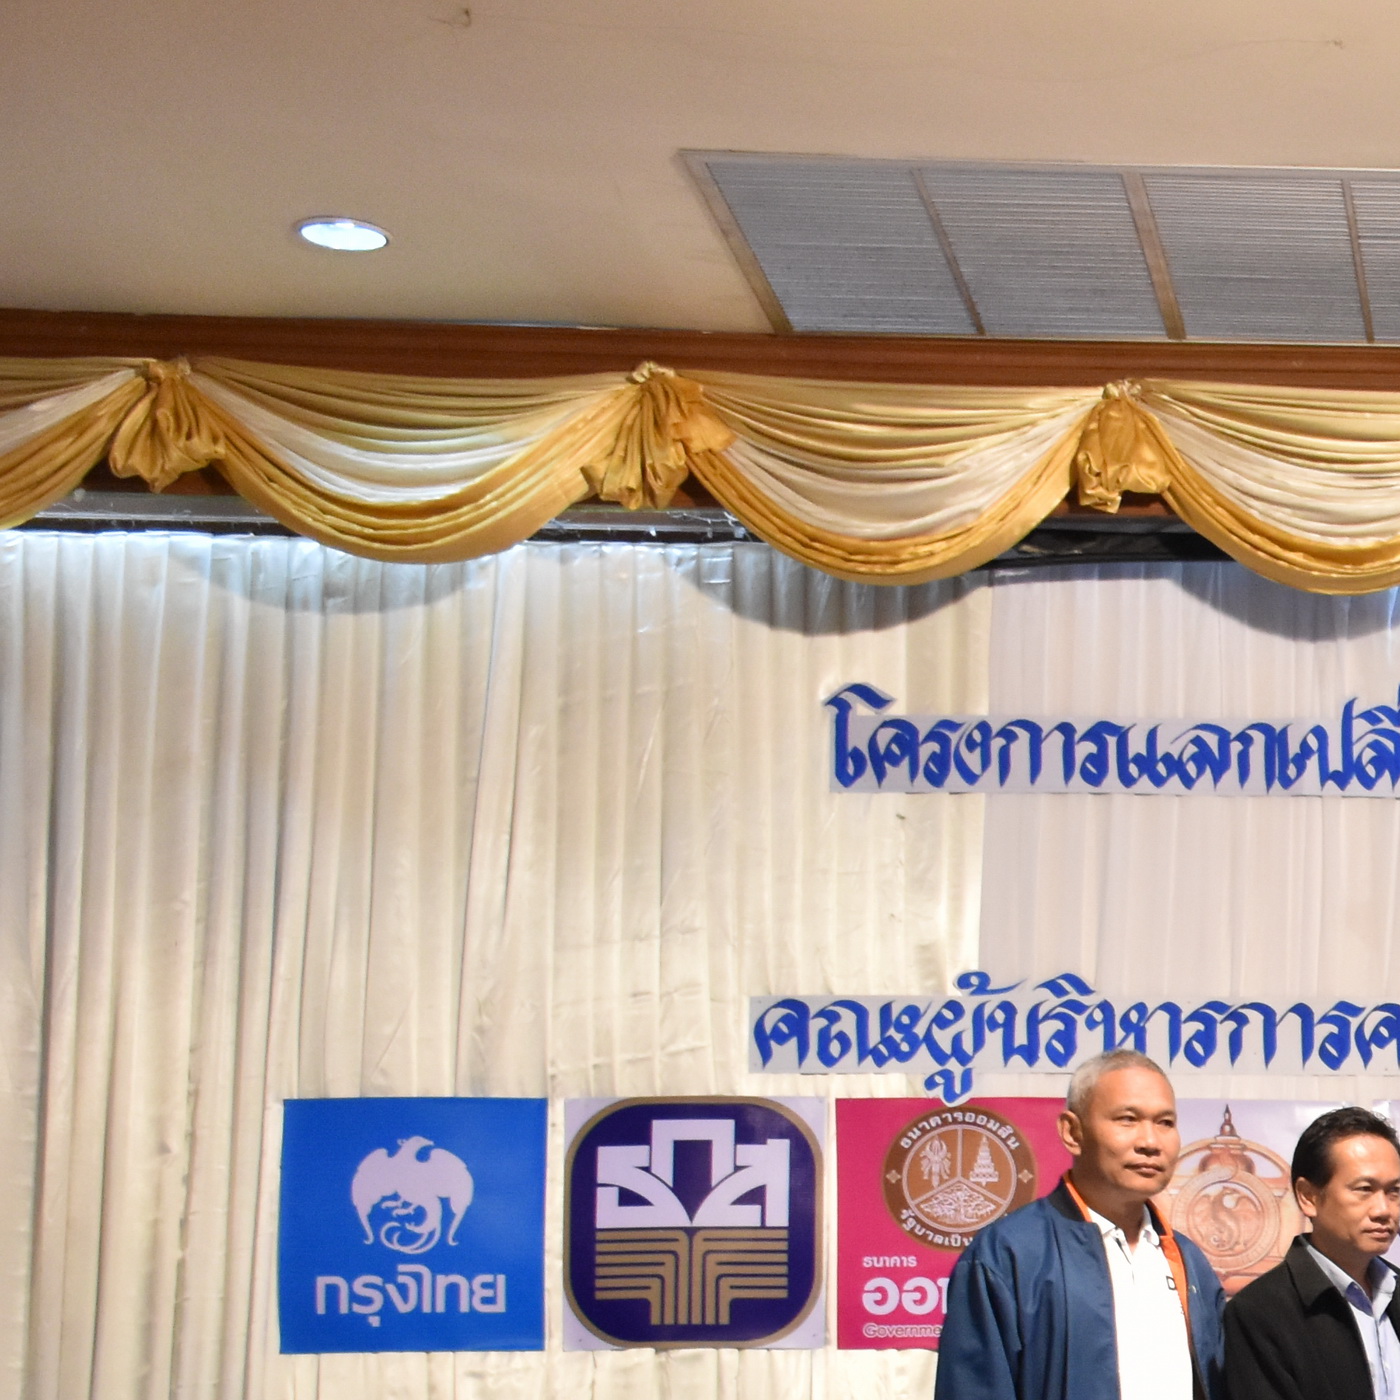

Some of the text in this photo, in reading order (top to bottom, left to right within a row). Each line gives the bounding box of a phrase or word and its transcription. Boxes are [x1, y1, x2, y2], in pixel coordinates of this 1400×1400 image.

[900, 1111, 1021, 1151] ธนาคารออมสิน
[862, 1255, 918, 1268] ธนาคาร
[316, 1264, 506, 1327] กรุงไทย
[863, 1323, 941, 1338] Governme
